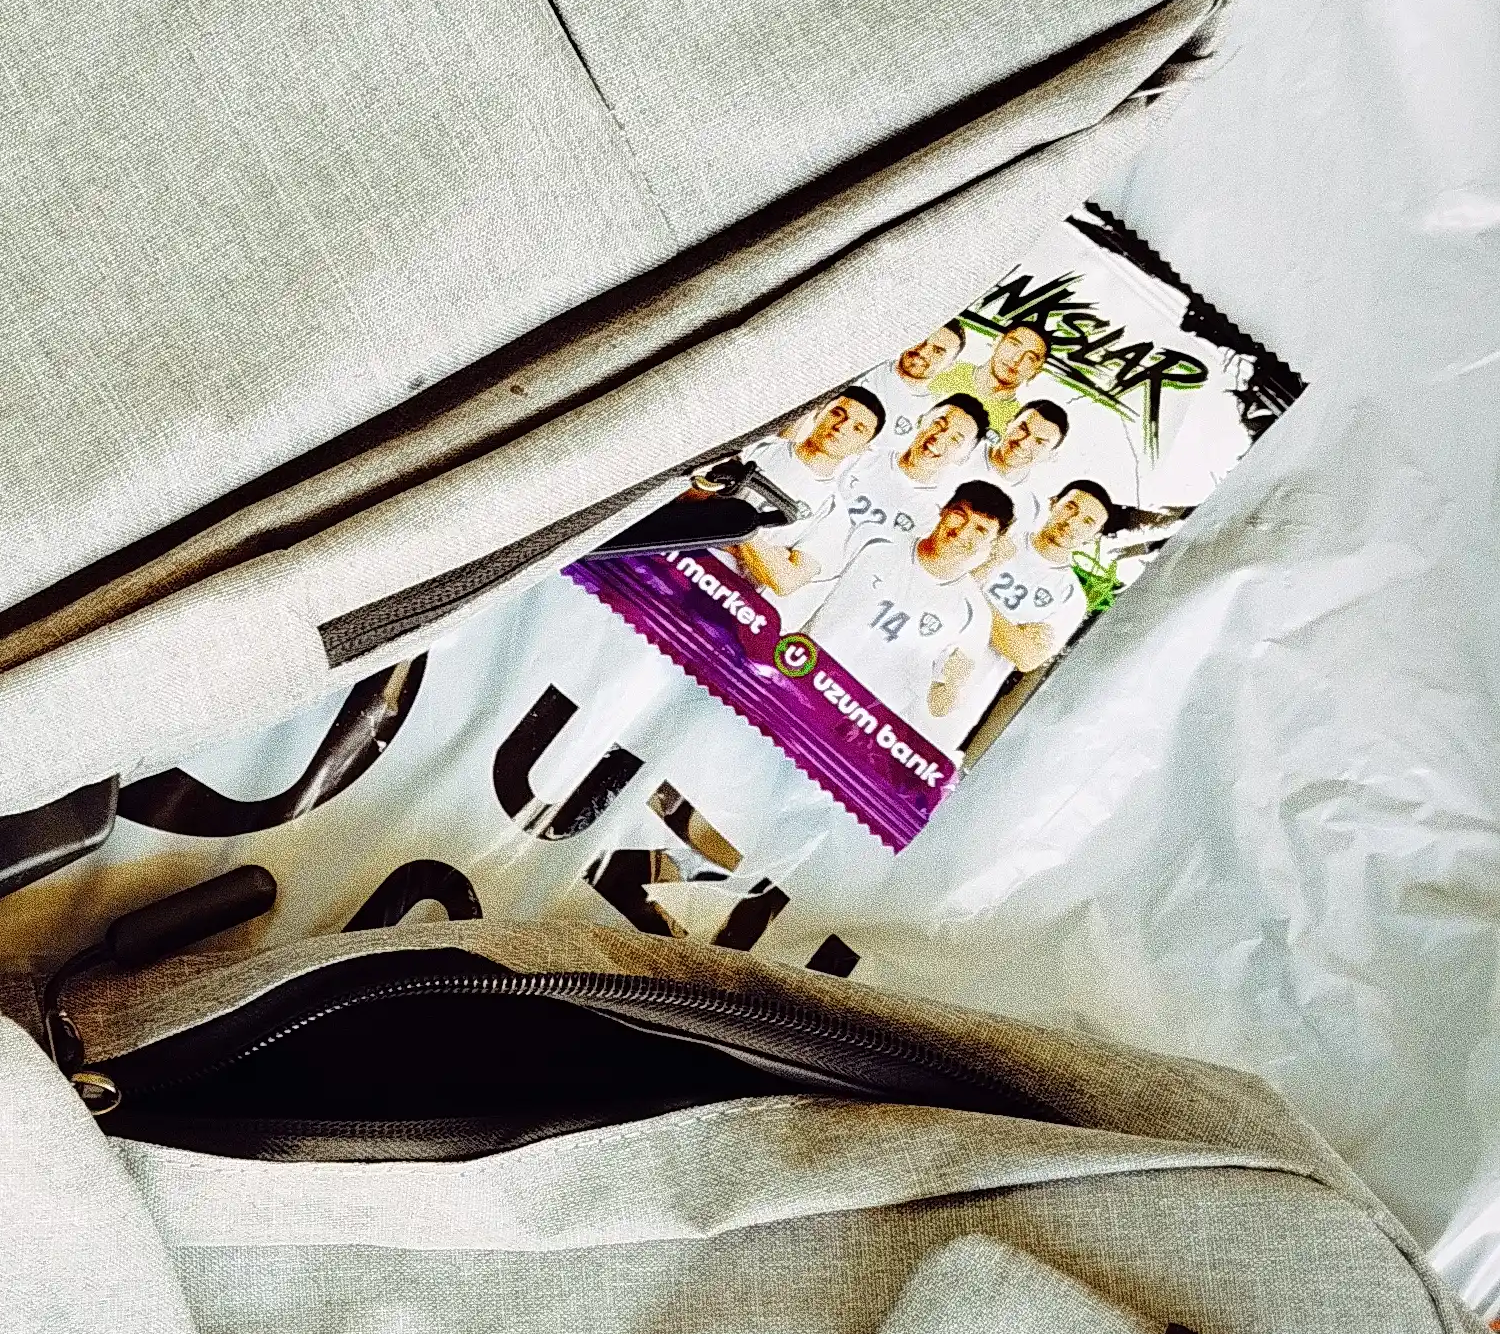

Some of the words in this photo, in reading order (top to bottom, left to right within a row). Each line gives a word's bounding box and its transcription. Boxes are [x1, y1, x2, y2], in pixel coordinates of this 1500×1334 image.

[675, 556, 768, 635] market
[869, 599, 911, 643] 14
[988, 571, 1029, 611] 23
[812, 670, 879, 735] uzum
[875, 723, 944, 788] bank
